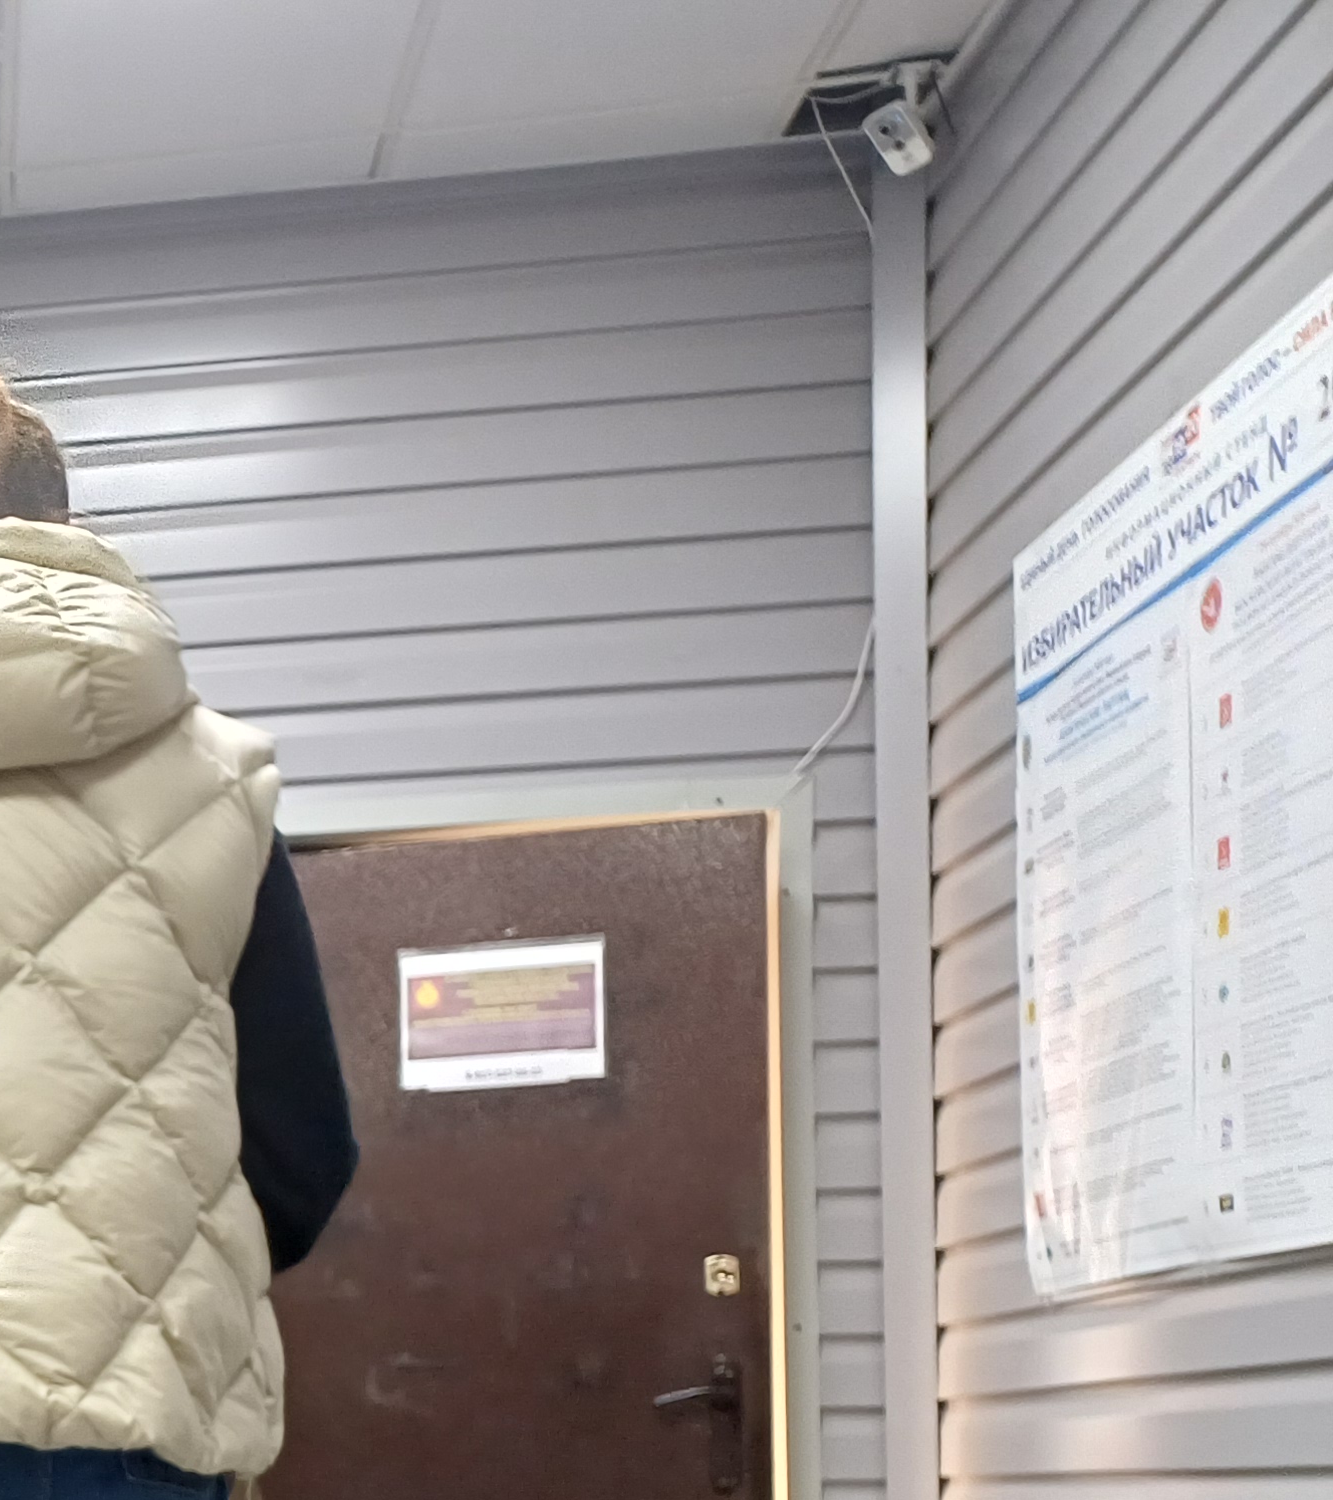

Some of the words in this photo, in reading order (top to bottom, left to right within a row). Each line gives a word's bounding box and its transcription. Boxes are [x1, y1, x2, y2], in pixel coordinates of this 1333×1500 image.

[1021, 530, 1164, 676] ИЗБИРАТЕЛЬНЫЙ
[1167, 456, 1261, 561] УЧАСТОК
[1268, 415, 1299, 483] №
